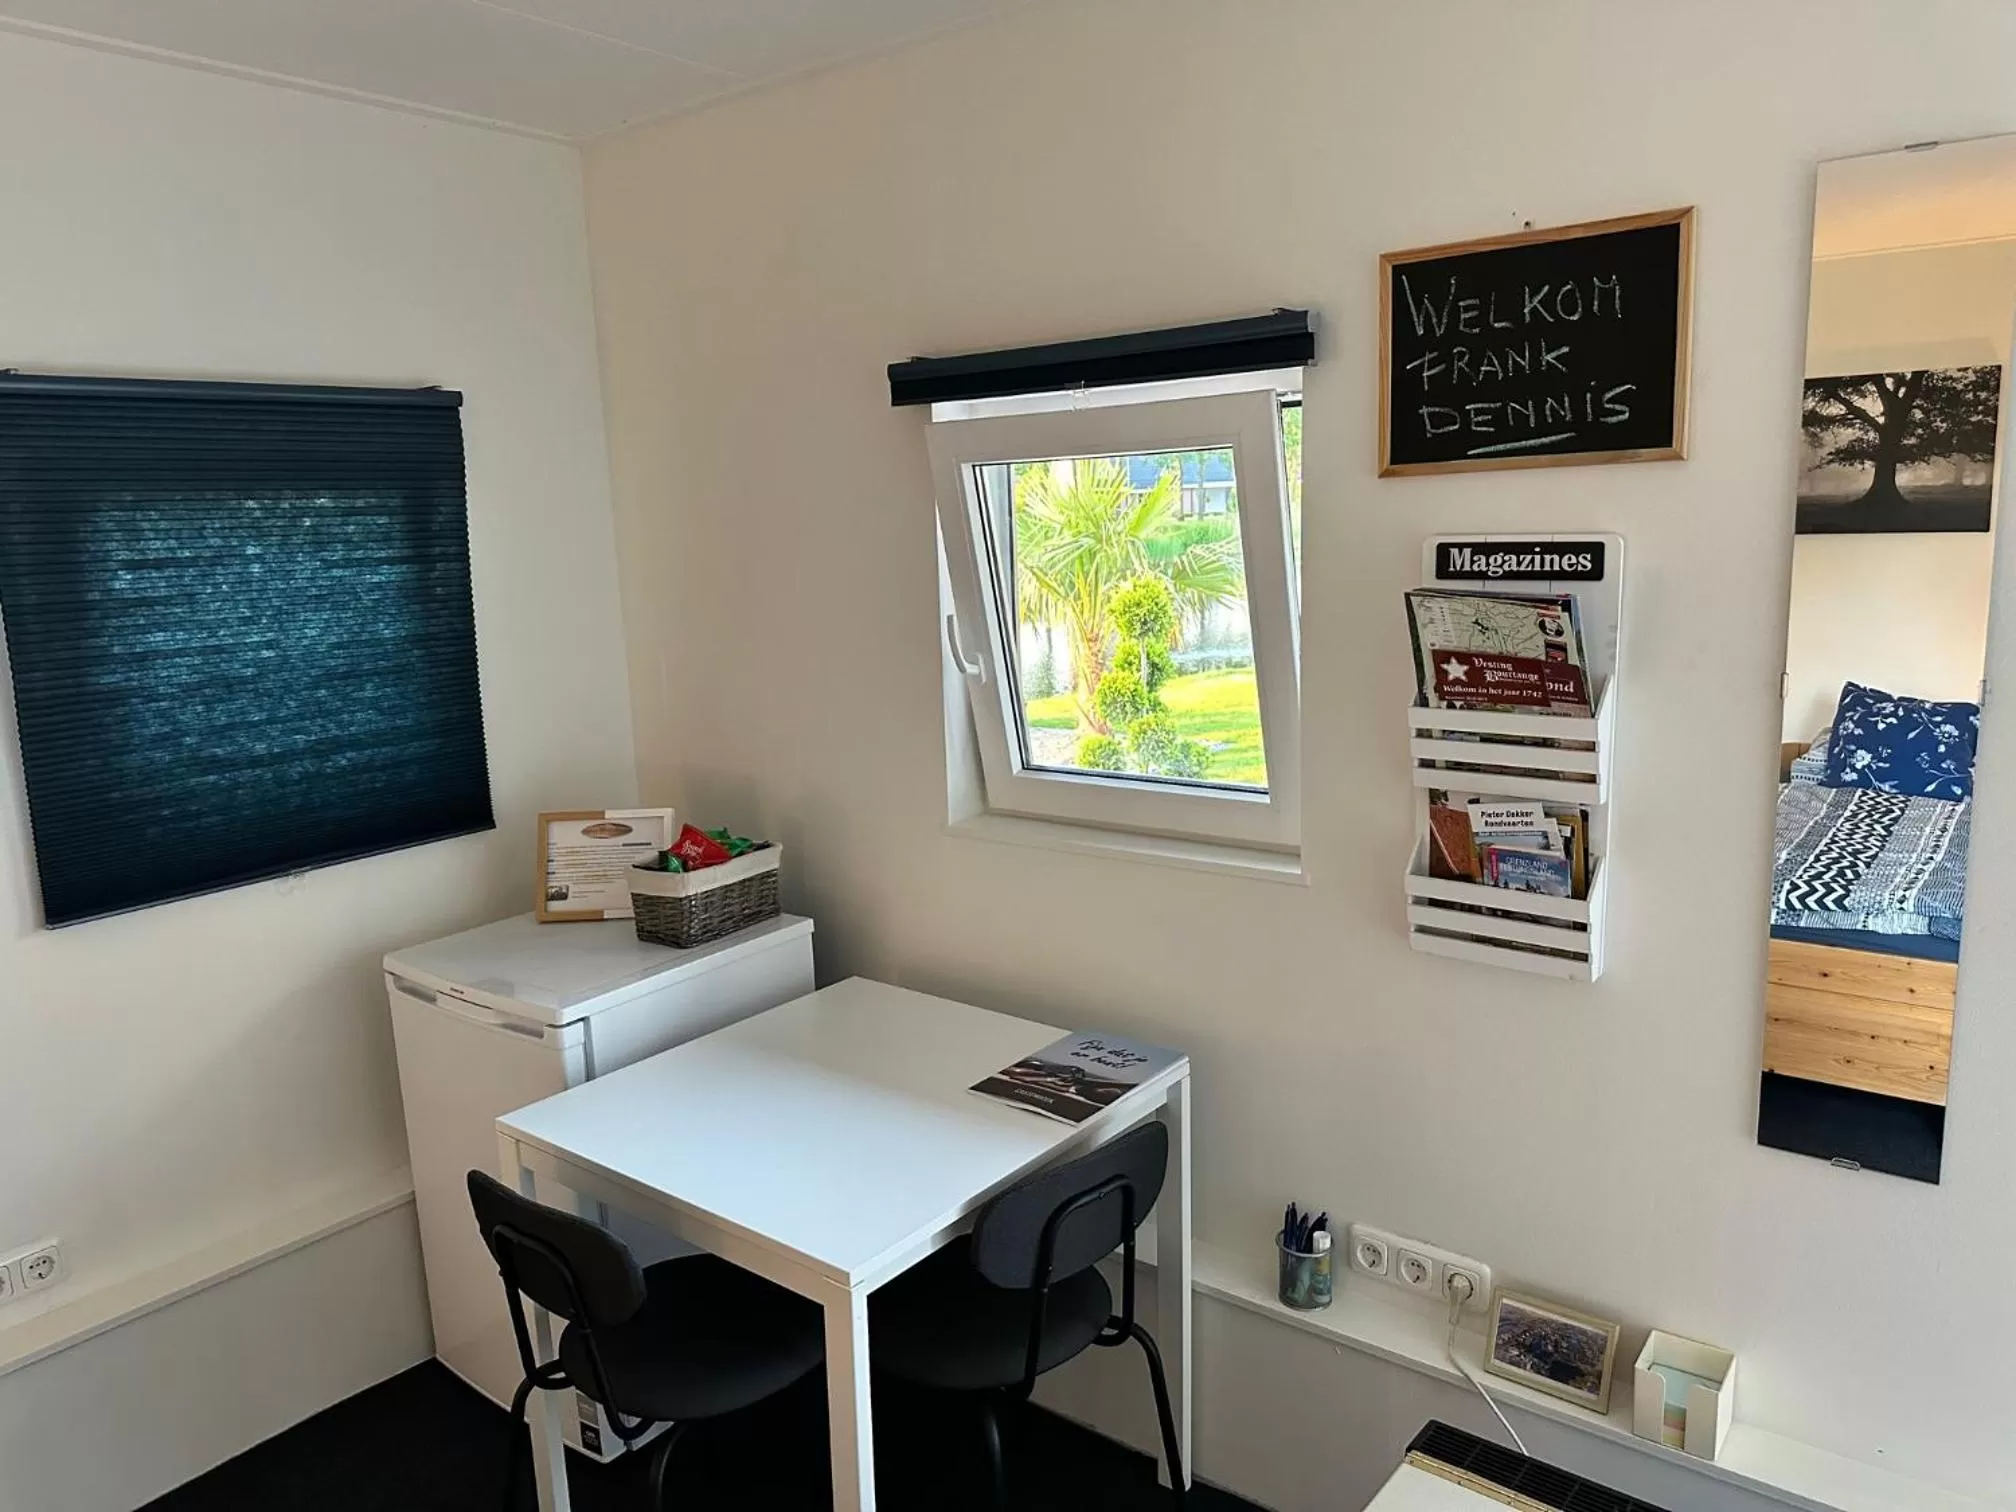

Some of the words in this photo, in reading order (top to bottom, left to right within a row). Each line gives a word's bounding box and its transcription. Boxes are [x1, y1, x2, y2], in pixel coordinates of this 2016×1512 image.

[1402, 274, 1622, 336] WELKOM
[1406, 338, 1570, 391] FRANK
[1448, 547, 1592, 576] Magazines
[1472, 656, 1513, 671] Vesting
[1443, 684, 1477, 694] Welkom
[1488, 685, 1502, 695] het
